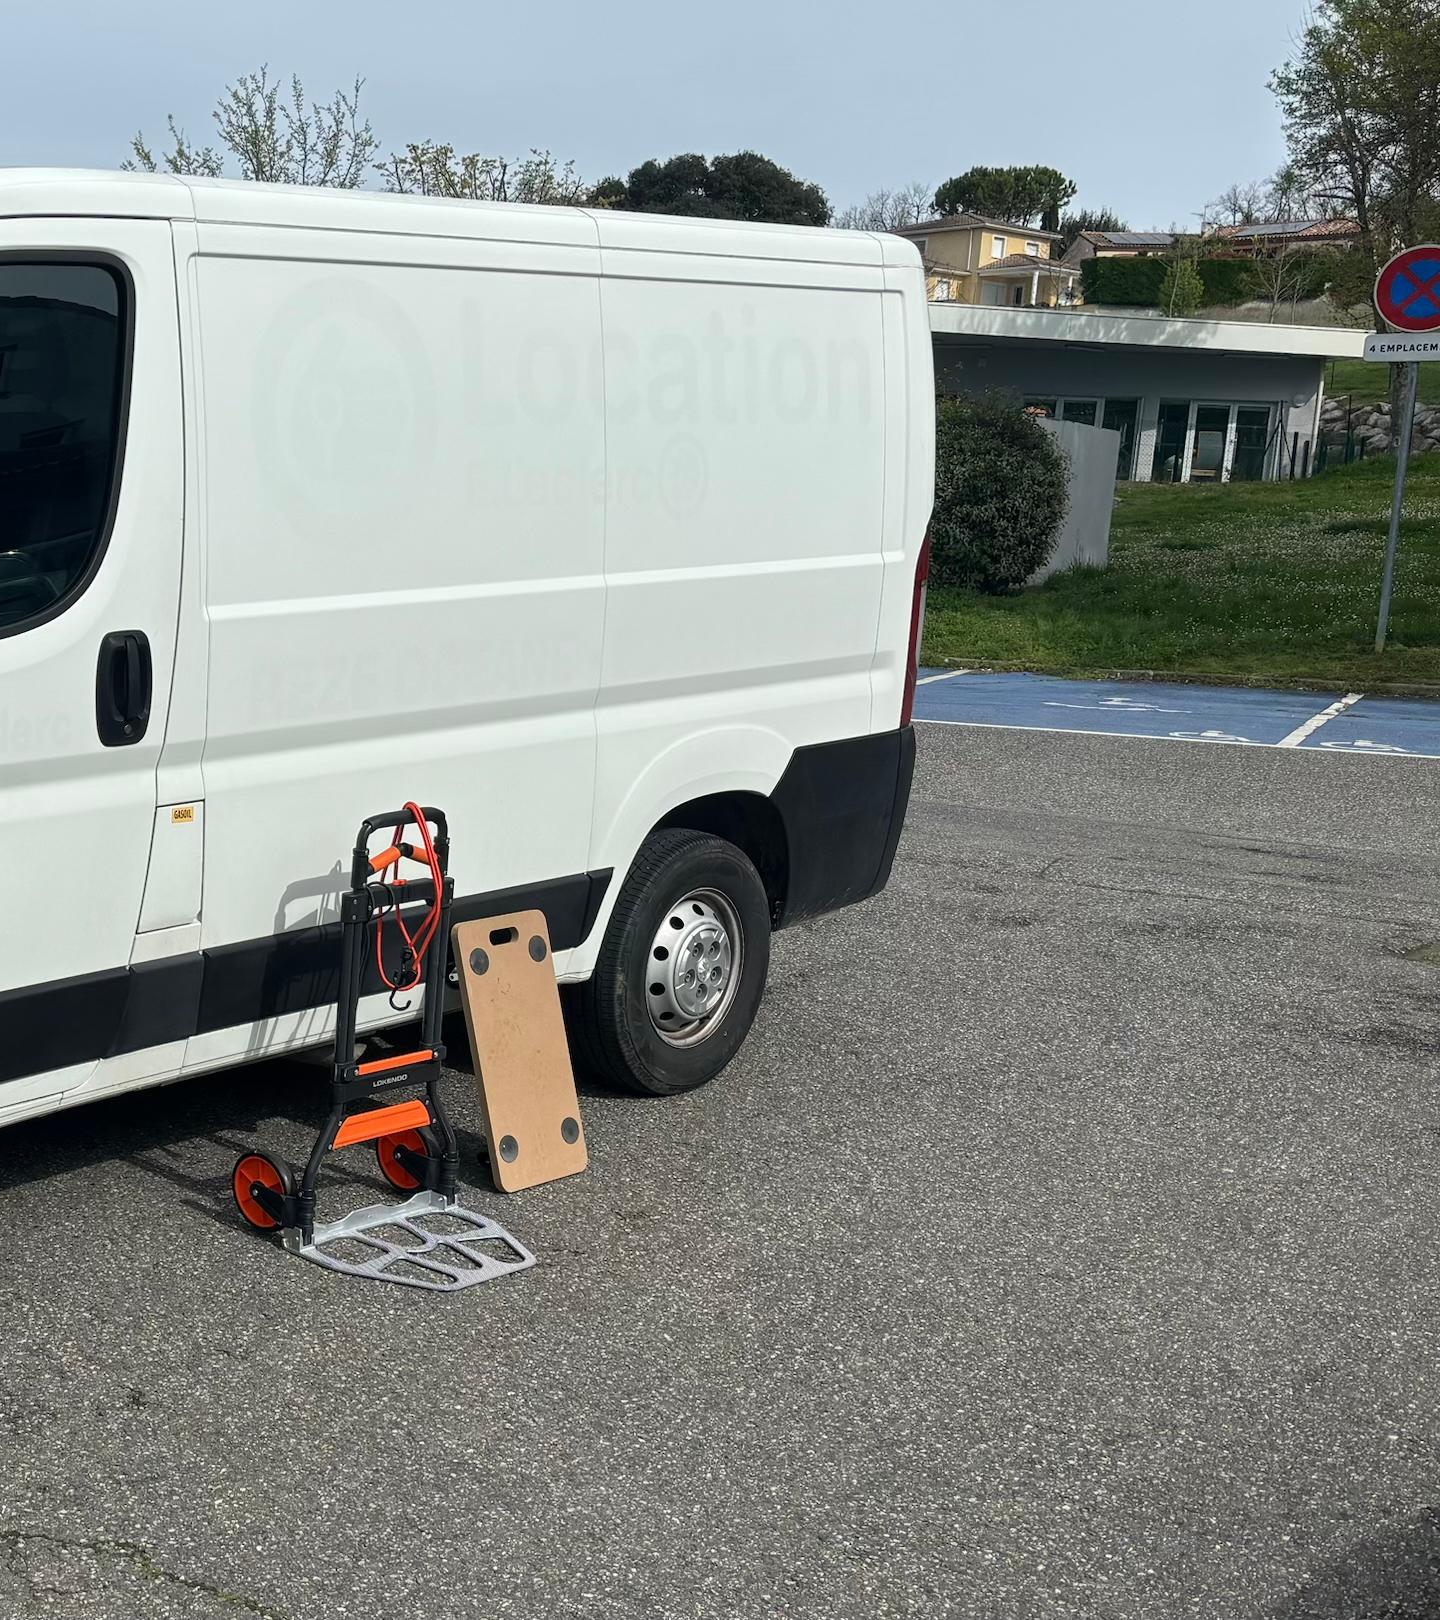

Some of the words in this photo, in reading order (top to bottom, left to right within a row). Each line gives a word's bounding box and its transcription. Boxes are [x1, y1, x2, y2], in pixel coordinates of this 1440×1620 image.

[1369, 344, 1376, 353] 4
[1380, 343, 1440, 353] EMPLACEM
[461, 297, 872, 426] Location
[174, 809, 192, 819] GASOIL
